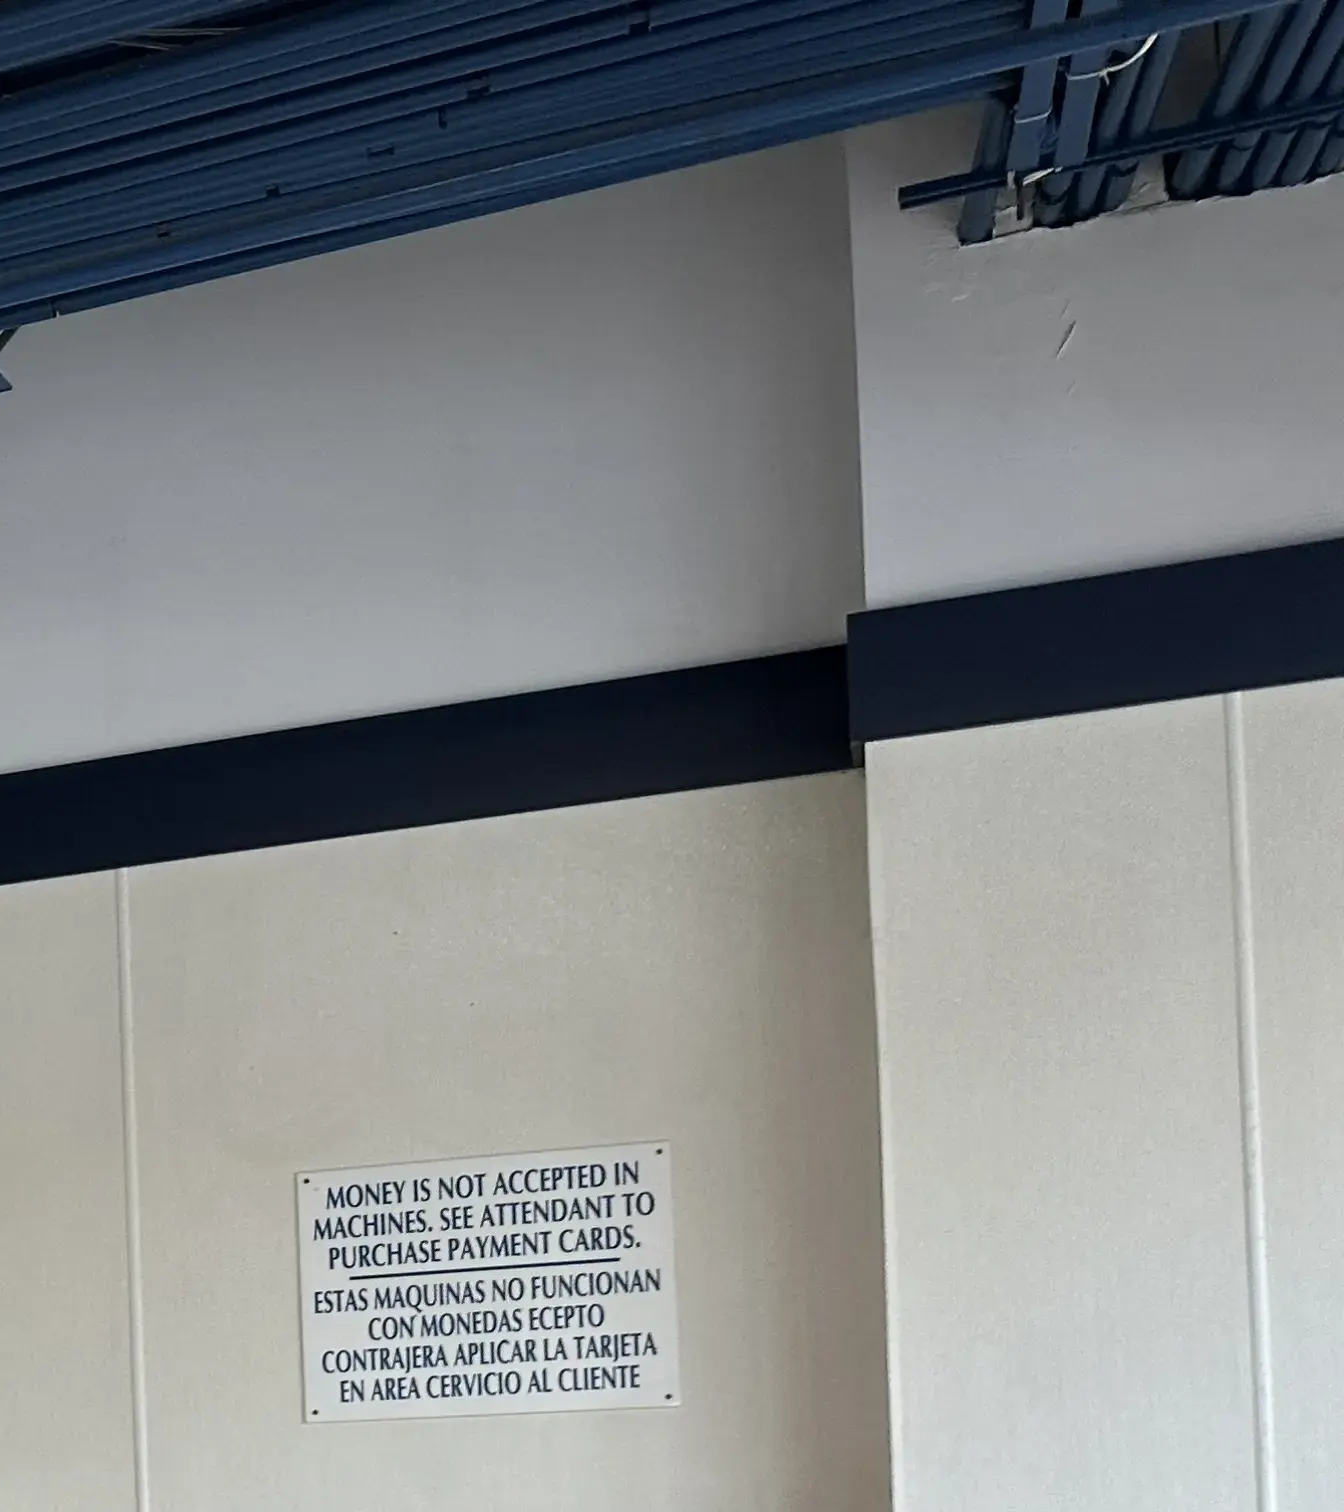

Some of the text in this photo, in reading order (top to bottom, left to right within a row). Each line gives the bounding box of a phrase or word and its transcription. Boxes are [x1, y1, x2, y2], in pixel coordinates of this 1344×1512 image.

[325, 1161, 640, 1210] MONEY IS NOT ACCEPTED IN
[313, 1191, 656, 1241] MACHINES. SEE ATTENDANT TO
[328, 1224, 642, 1270] PURCHASE PAYMENT CARDS.
[314, 1268, 662, 1314] ESTAS MAQUINAS NO FUNCIONAN
[368, 1303, 606, 1341] CON MONEDAS ECEPTO
[321, 1332, 658, 1374] CONTRAJERA APLICAR LA TARJETA
[340, 1364, 641, 1403] EN AREA CERVICIO AL CLIENTE
